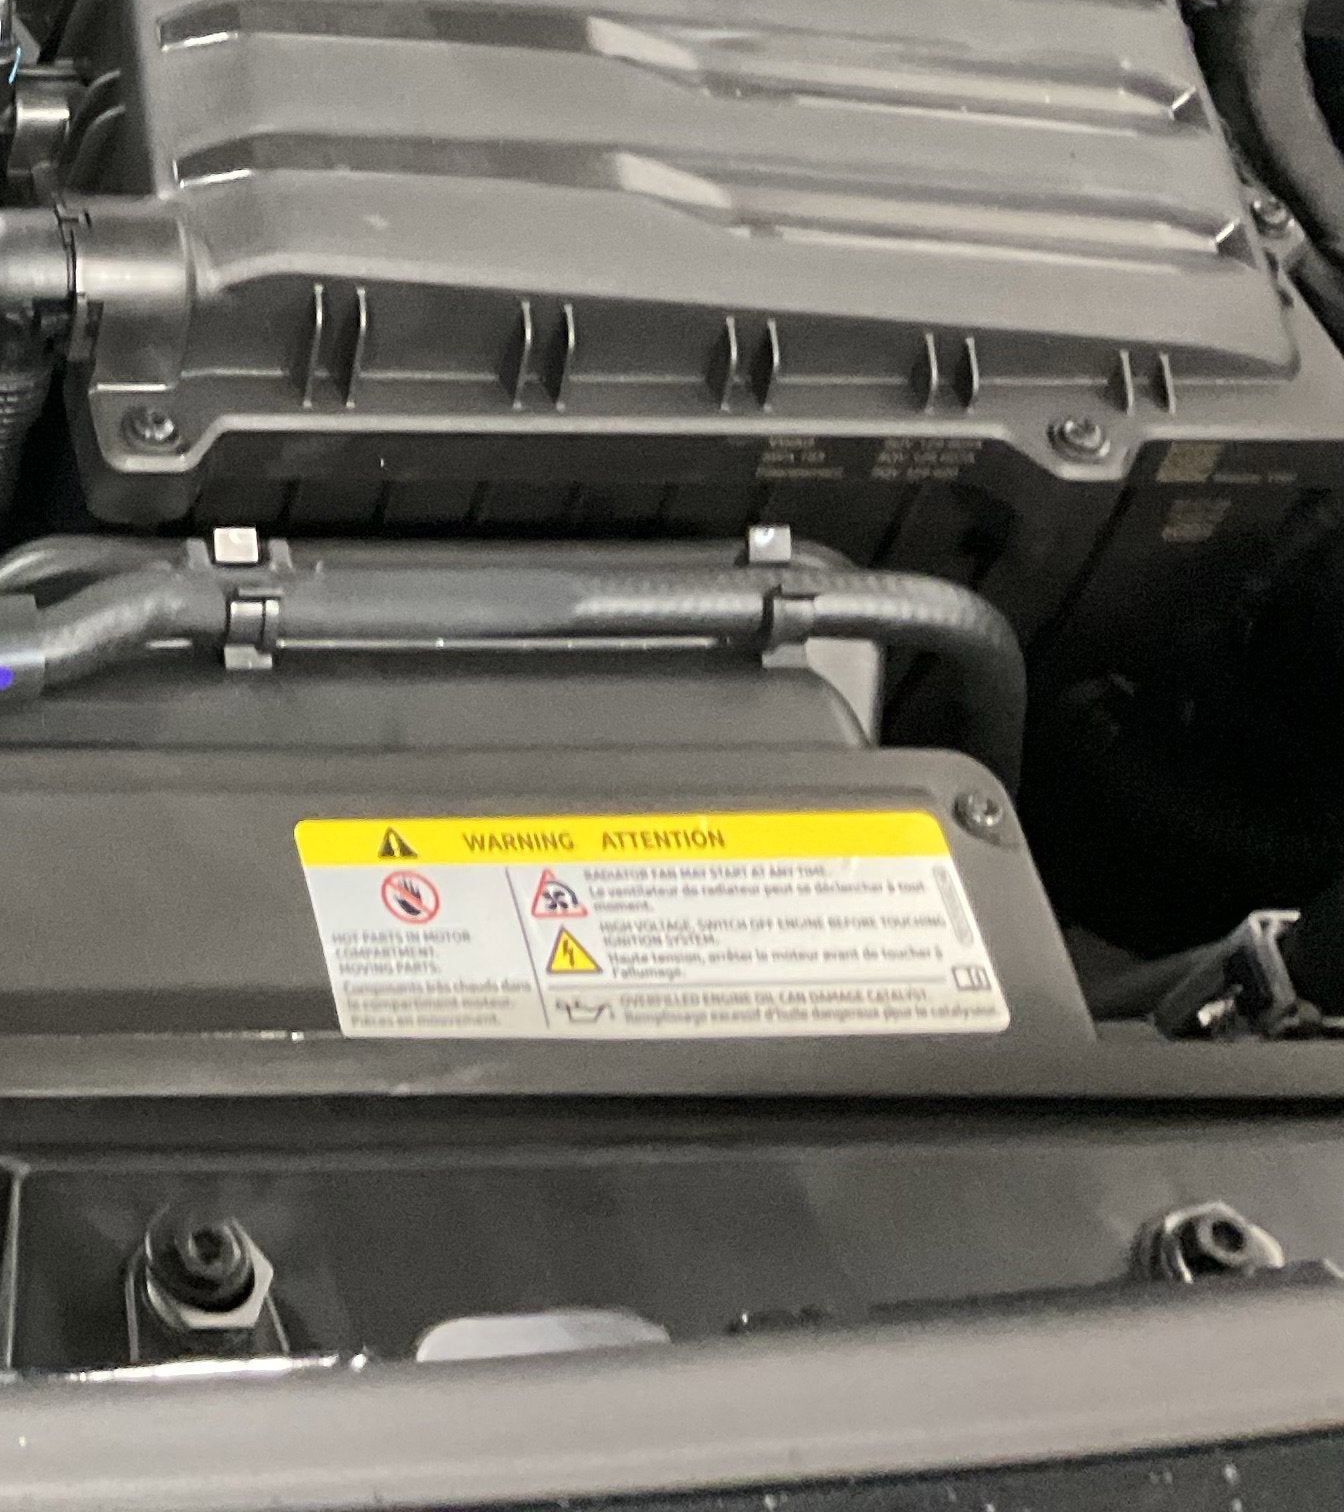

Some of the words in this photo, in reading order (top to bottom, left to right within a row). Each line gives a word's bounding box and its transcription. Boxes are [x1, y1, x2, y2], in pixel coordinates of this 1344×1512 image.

[463, 832, 575, 851] WARNING
[601, 828, 726, 851] ATTENTION
[583, 868, 648, 882] RADIATOR
[650, 867, 678, 881] FAN
[679, 867, 707, 880] MAY
[709, 867, 747, 880] START
[749, 866, 765, 879] AT
[769, 865, 793, 878] ANY
[607, 885, 678, 899] ventilateur
[700, 883, 760, 897] radiateur
[763, 883, 793, 897] peut
[795, 883, 812, 894] se
[898, 880, 925, 893] tout
[599, 919, 633, 933] HIGH
[697, 919, 749, 932] SWITCH
[750, 918, 774, 931] OFF
[776, 916, 825, 931] ENGINE
[827, 916, 877, 930] BEFORE
[879, 915, 947, 930] TOUCHING
[330, 930, 359, 944] HOT
[361, 930, 404, 944] PARTS
[405, 930, 422, 943] IN
[423, 929, 471, 943] MOTOR
[603, 935, 663, 948] IGNITION
[608, 952, 649, 965] Haute
[771, 949, 820, 962] moteur
[822, 949, 859, 963] avant
[861, 947, 879, 961] de
[880, 947, 932, 961] toucher
[338, 961, 394, 975] MOVING
[620, 993, 700, 1007] OVERFILLED
[701, 992, 751, 1006] ENGINE
[753, 992, 778, 1005] OIL
[779, 990, 807, 1004] CAN
[809, 990, 867, 1004] DAMAGE
